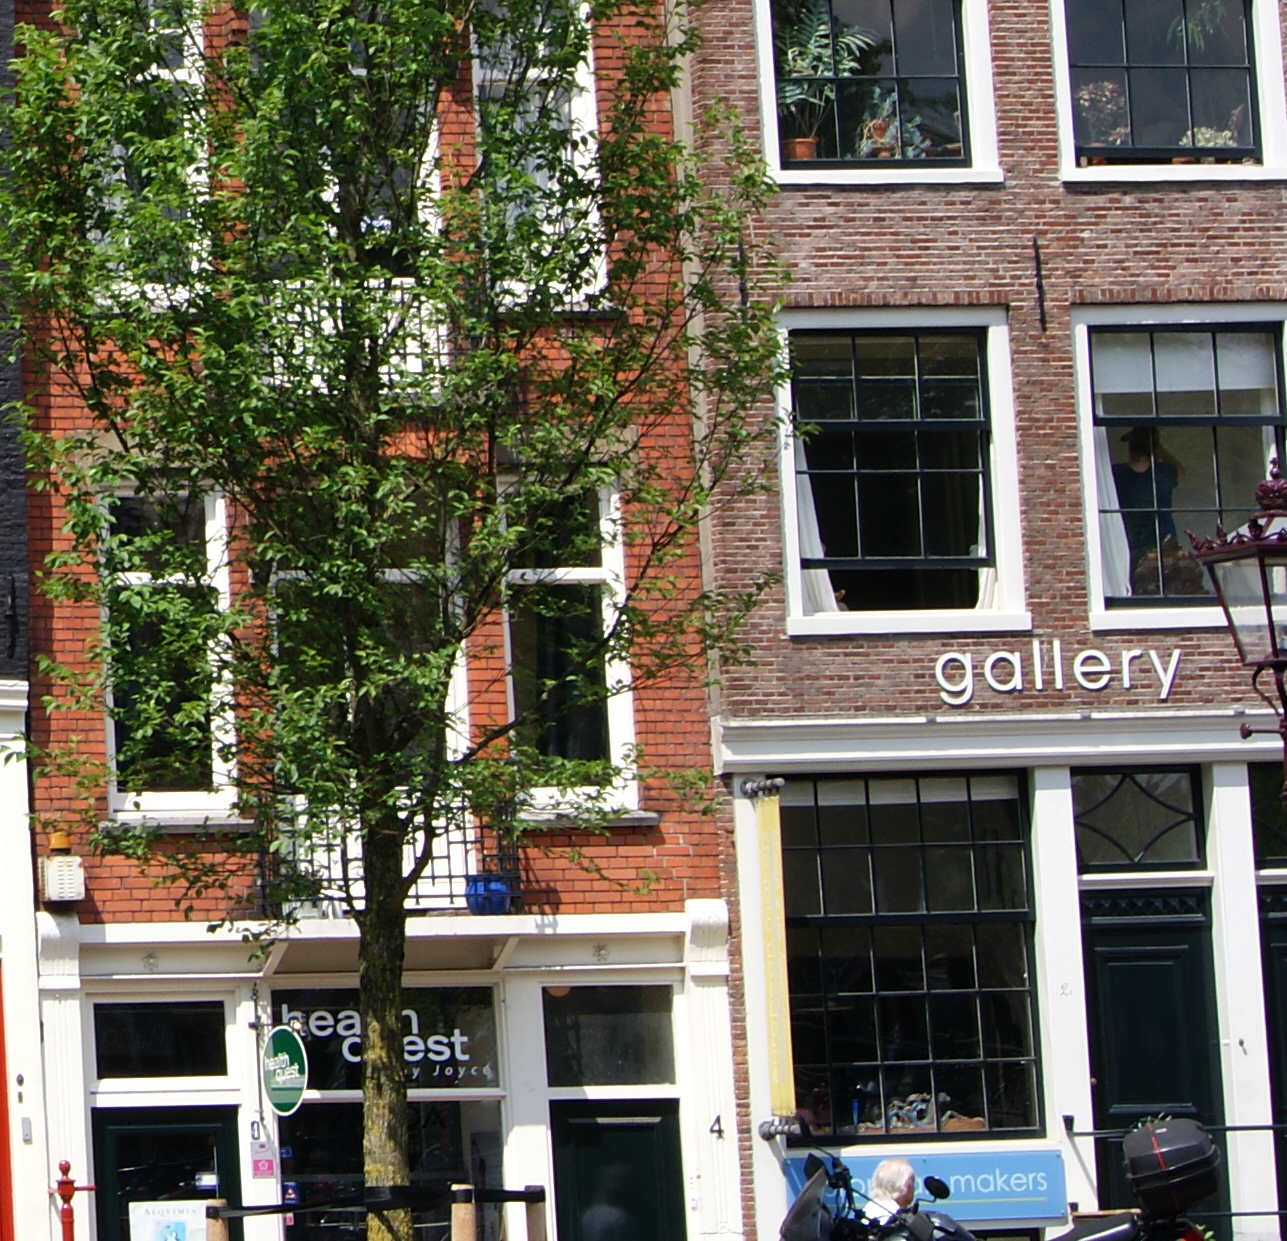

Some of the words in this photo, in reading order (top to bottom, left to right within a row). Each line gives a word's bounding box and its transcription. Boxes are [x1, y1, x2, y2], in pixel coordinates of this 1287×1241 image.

[934, 639, 1181, 706] gallery
[263, 1052, 290, 1071] health
[275, 1062, 300, 1085] quest
[709, 1114, 725, 1141] 4
[951, 1168, 1048, 1193] makers
